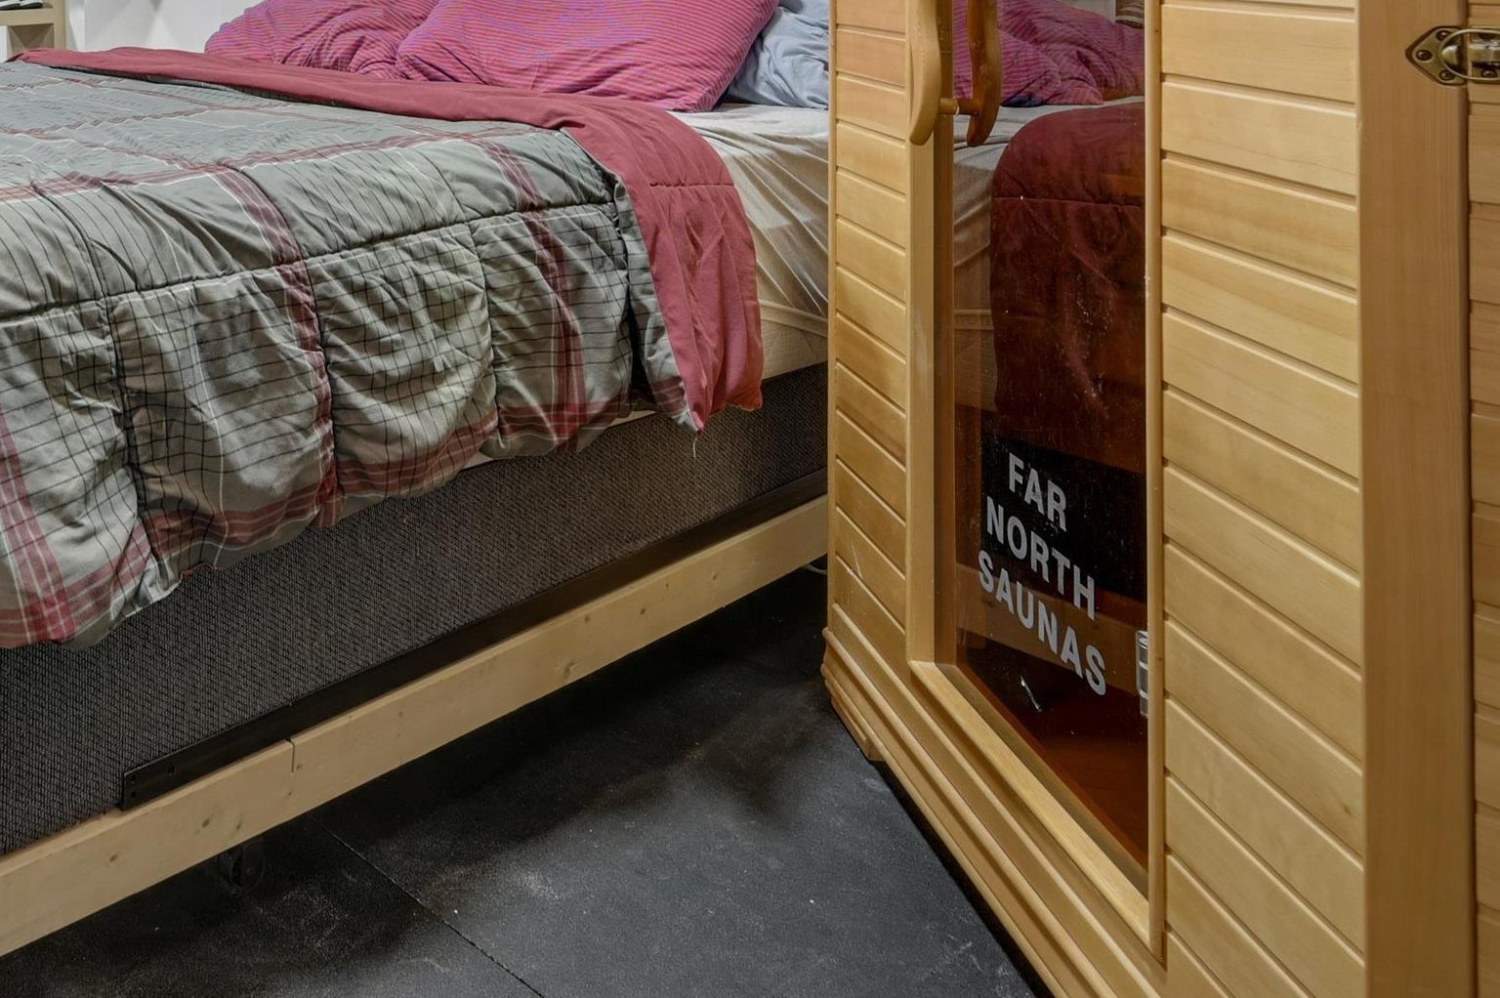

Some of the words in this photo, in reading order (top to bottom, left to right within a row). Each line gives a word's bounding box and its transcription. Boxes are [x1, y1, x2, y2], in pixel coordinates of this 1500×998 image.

[1008, 452, 1067, 532] FAR
[986, 496, 1096, 621] NORTH
[978, 549, 1107, 696] SAUNAS
